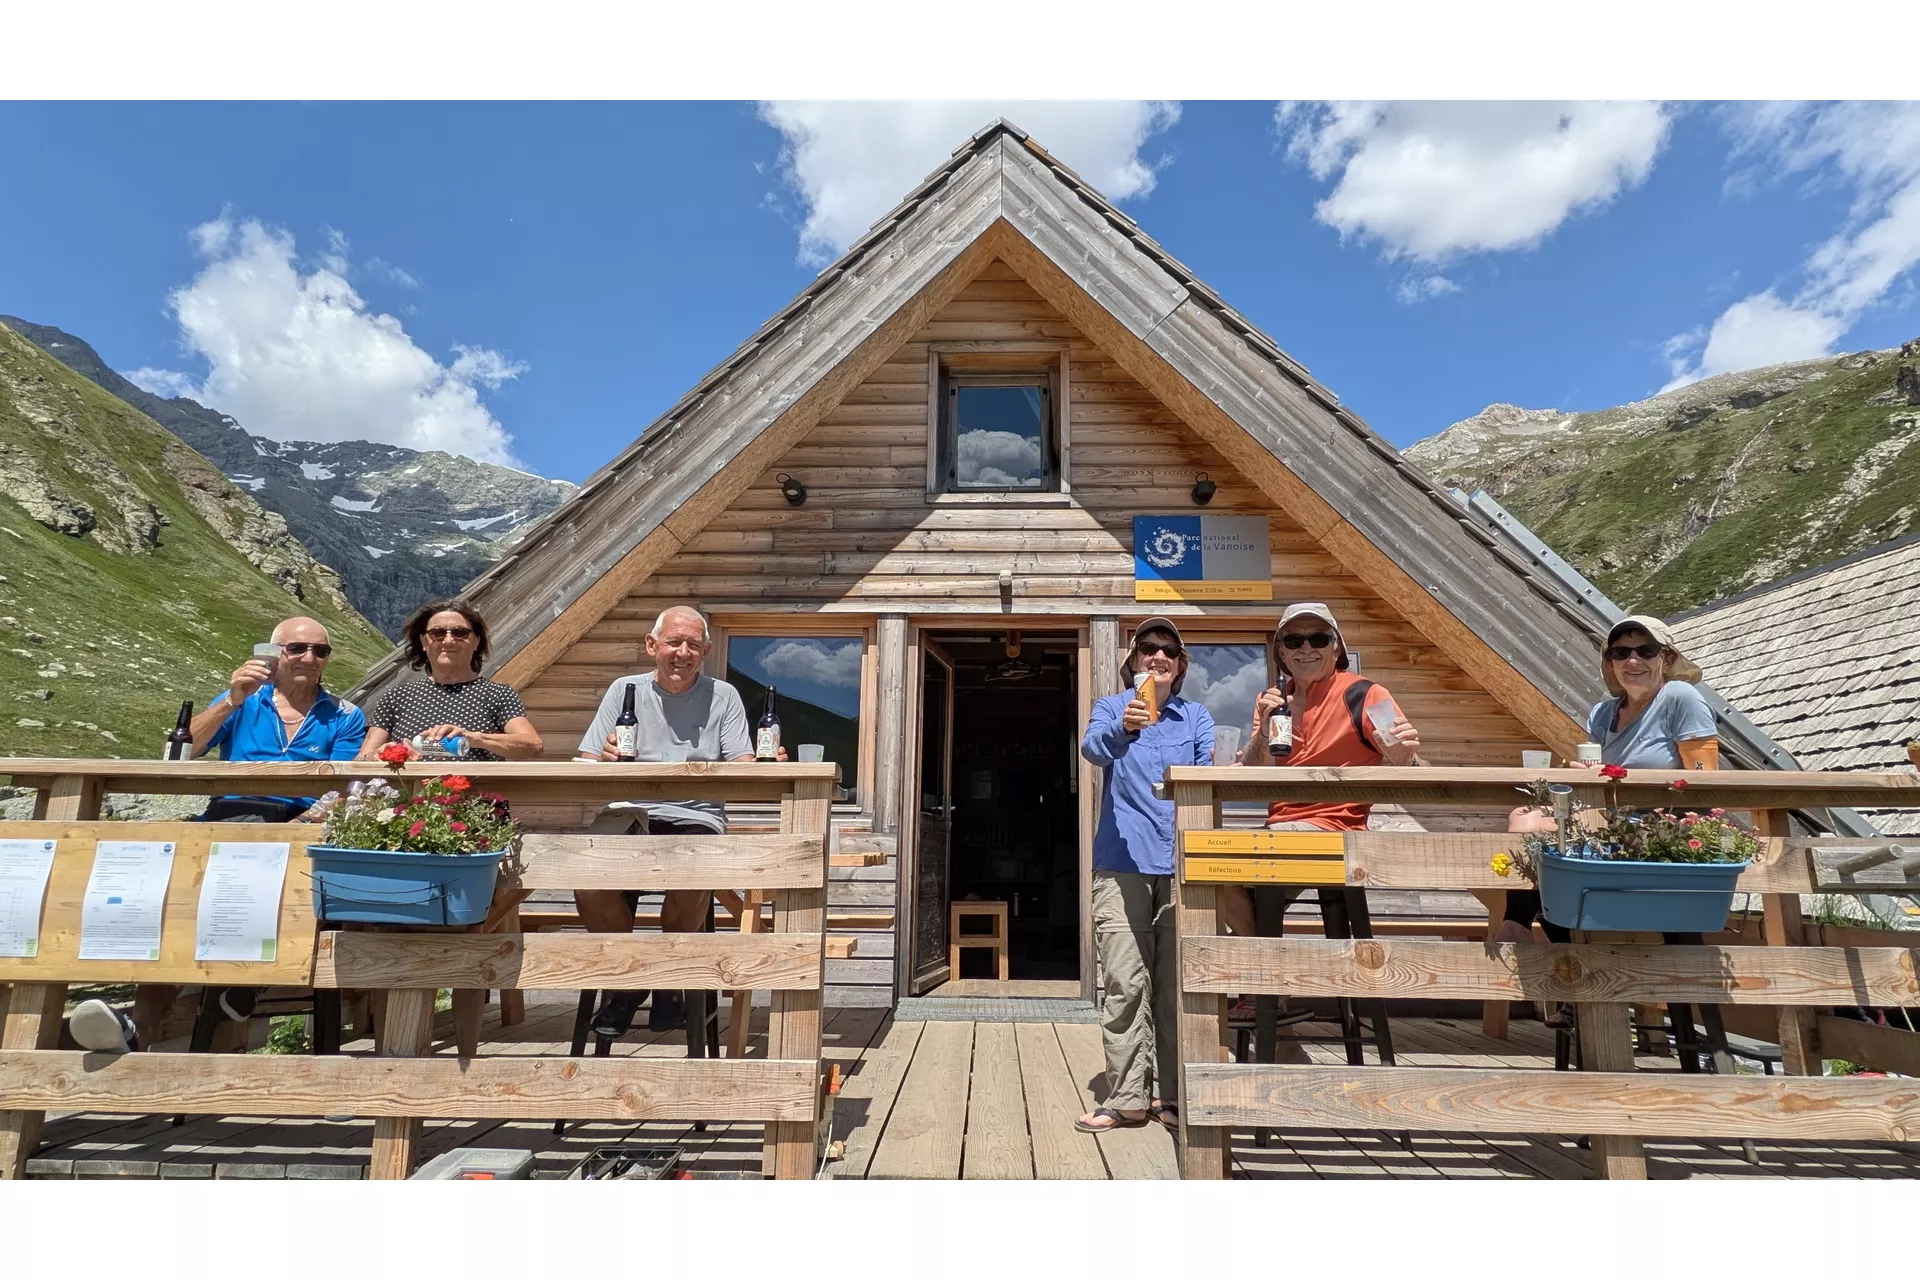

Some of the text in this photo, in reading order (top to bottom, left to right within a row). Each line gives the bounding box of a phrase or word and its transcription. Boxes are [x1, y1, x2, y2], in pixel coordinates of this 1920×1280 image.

[1191, 543, 1255, 551] de la Vanoise
[1208, 866, 1242, 874] Réfectoire
